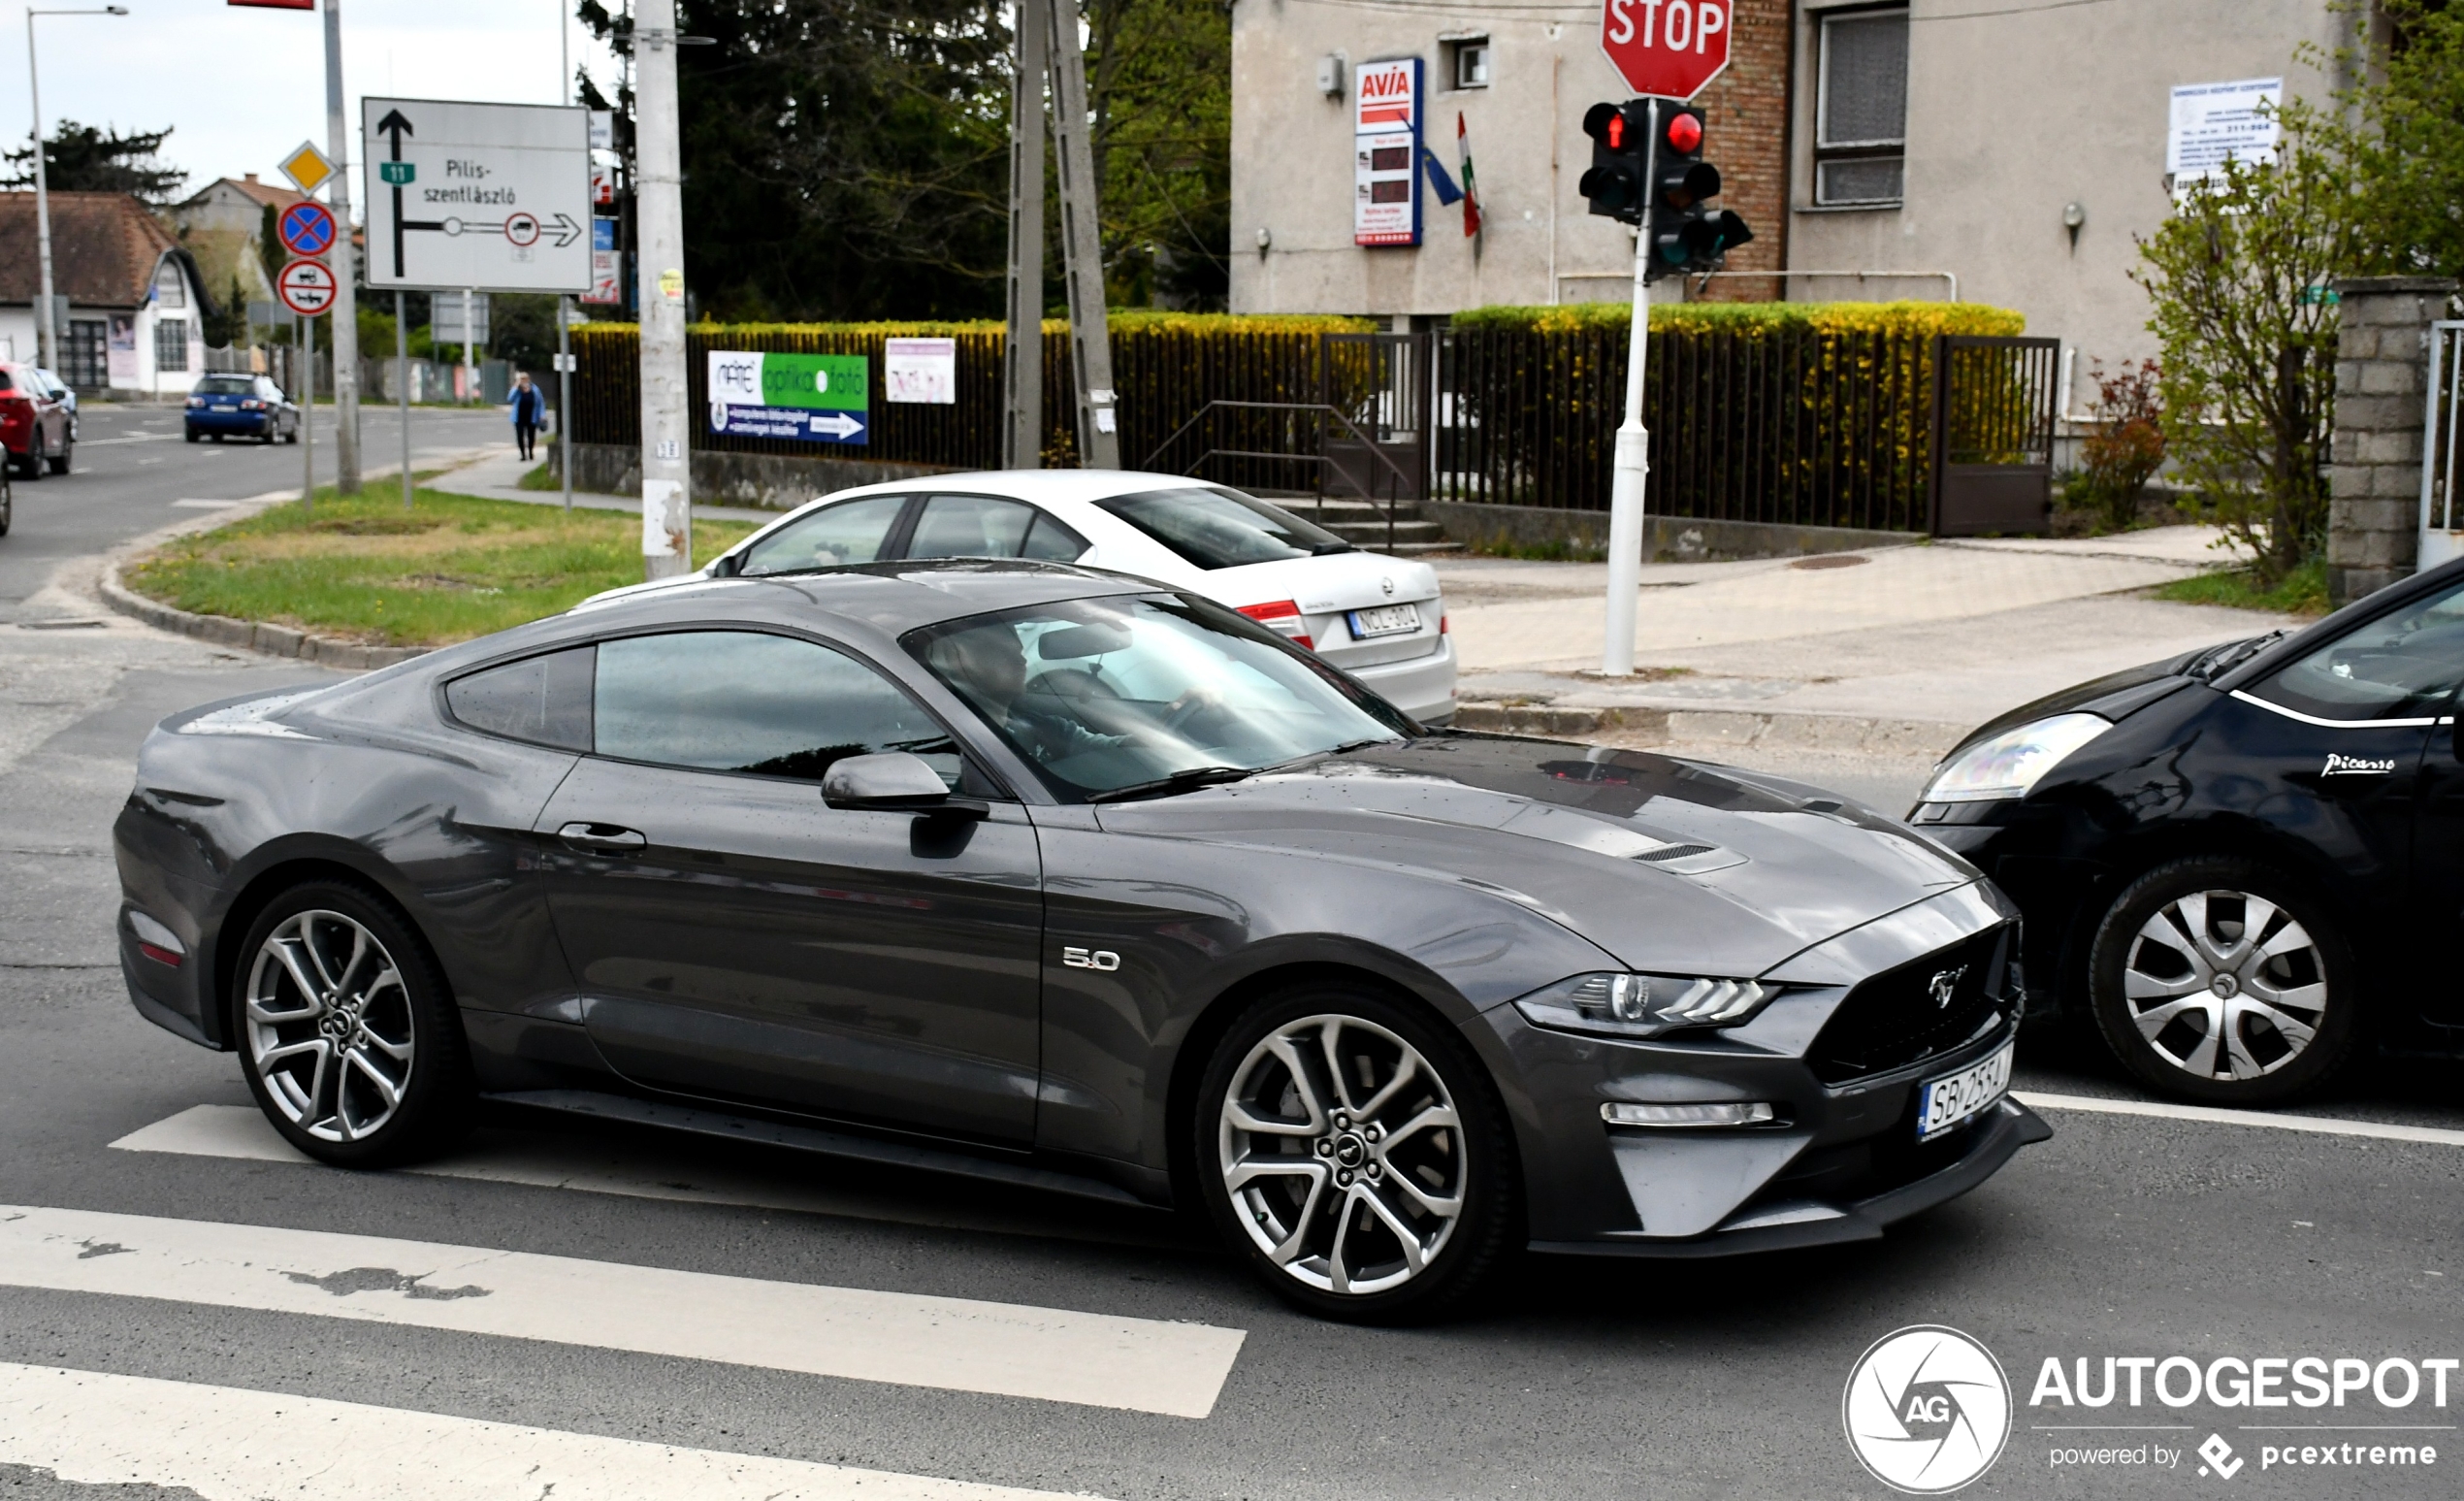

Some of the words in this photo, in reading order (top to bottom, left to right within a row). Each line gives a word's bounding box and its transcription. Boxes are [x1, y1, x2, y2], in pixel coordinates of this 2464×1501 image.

[1608, 0, 1724, 54] STOP
[390, 165, 405, 181] 11
[447, 159, 492, 179] Pilis-
[424, 187, 516, 206] szentlászló
[2320, 753, 2396, 777] Picasso
[1063, 946, 1120, 971] 5.0
[1931, 1079, 1960, 1125] SB
